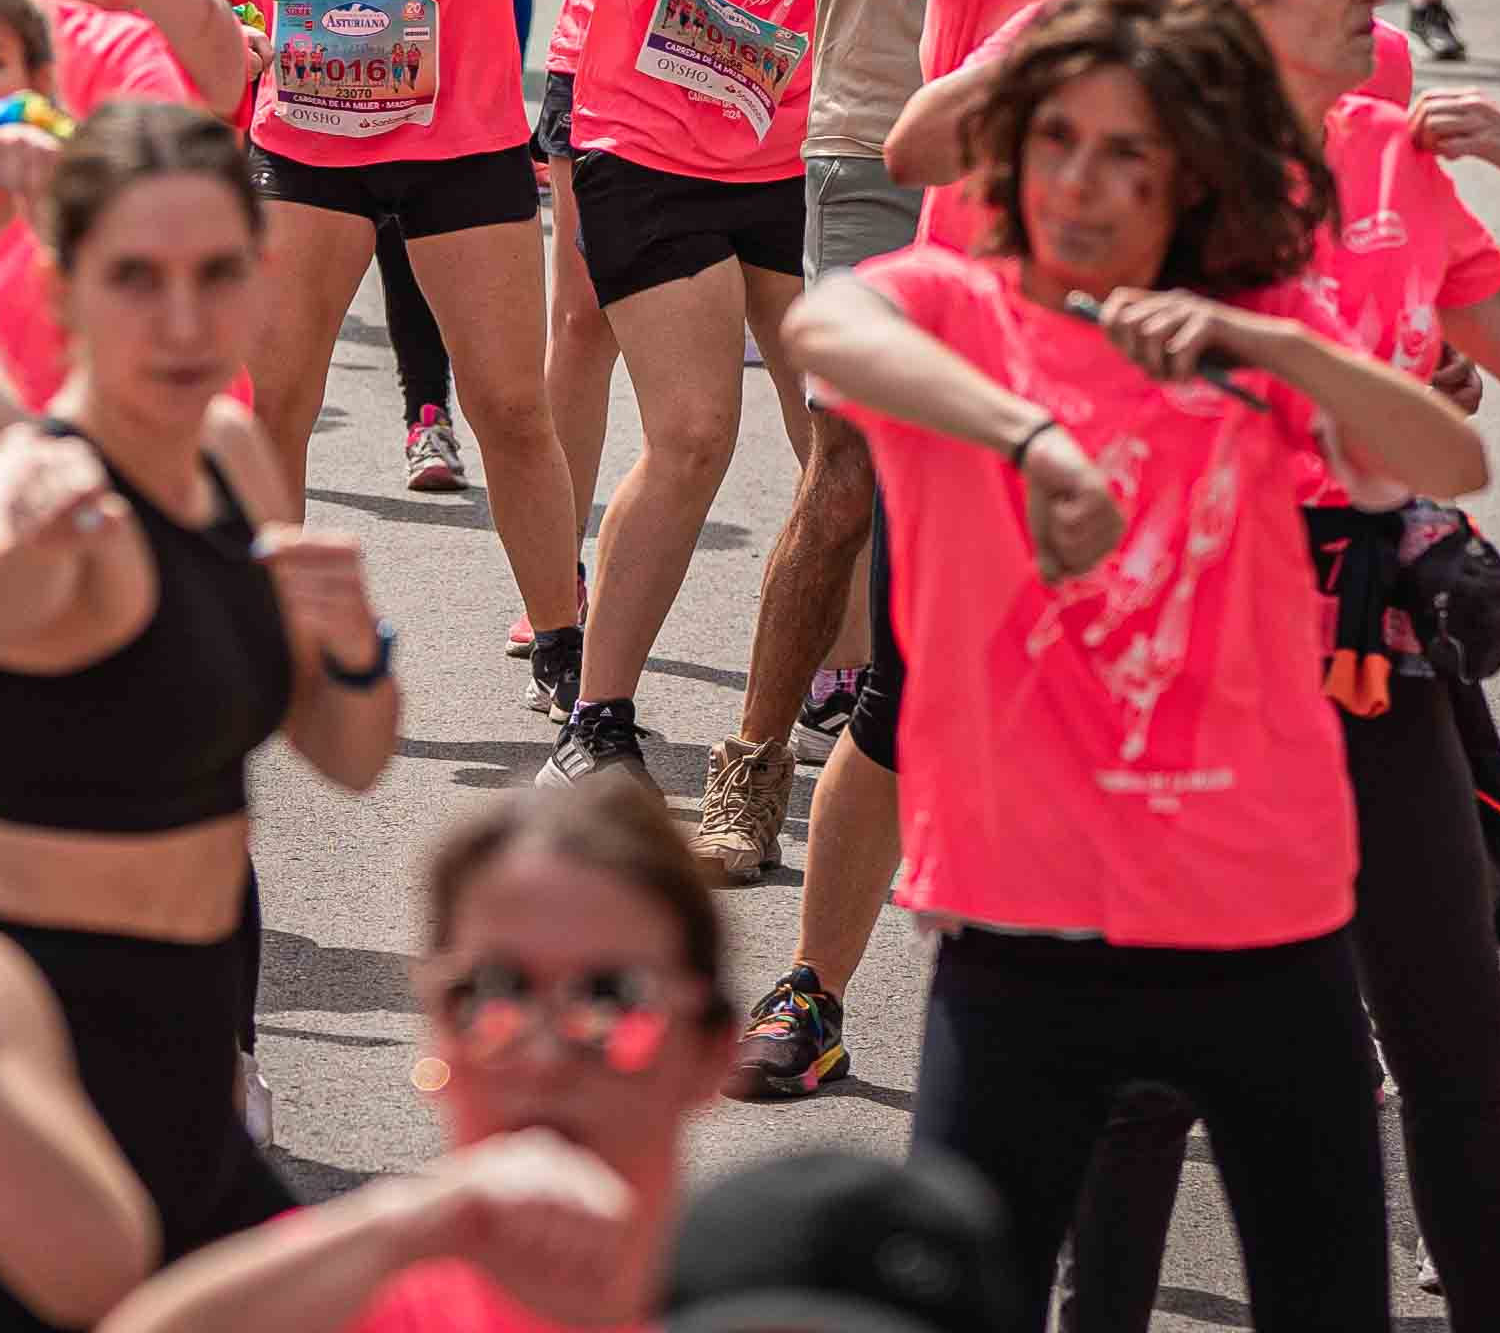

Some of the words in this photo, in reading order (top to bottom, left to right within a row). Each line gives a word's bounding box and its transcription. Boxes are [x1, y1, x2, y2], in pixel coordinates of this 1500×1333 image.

[407, 2, 422, 15] 20
[326, 16, 385, 29] ASTURIANA
[665, 41, 701, 61] CARRERA
[326, 58, 387, 82] 016
[657, 57, 709, 84] OYSHO
[293, 94, 326, 107] CARRERA
[328, 99, 339, 108] DE
[340, 100, 351, 109] LA
[335, 88, 372, 99] 23070
[292, 108, 341, 126] OYSHO
